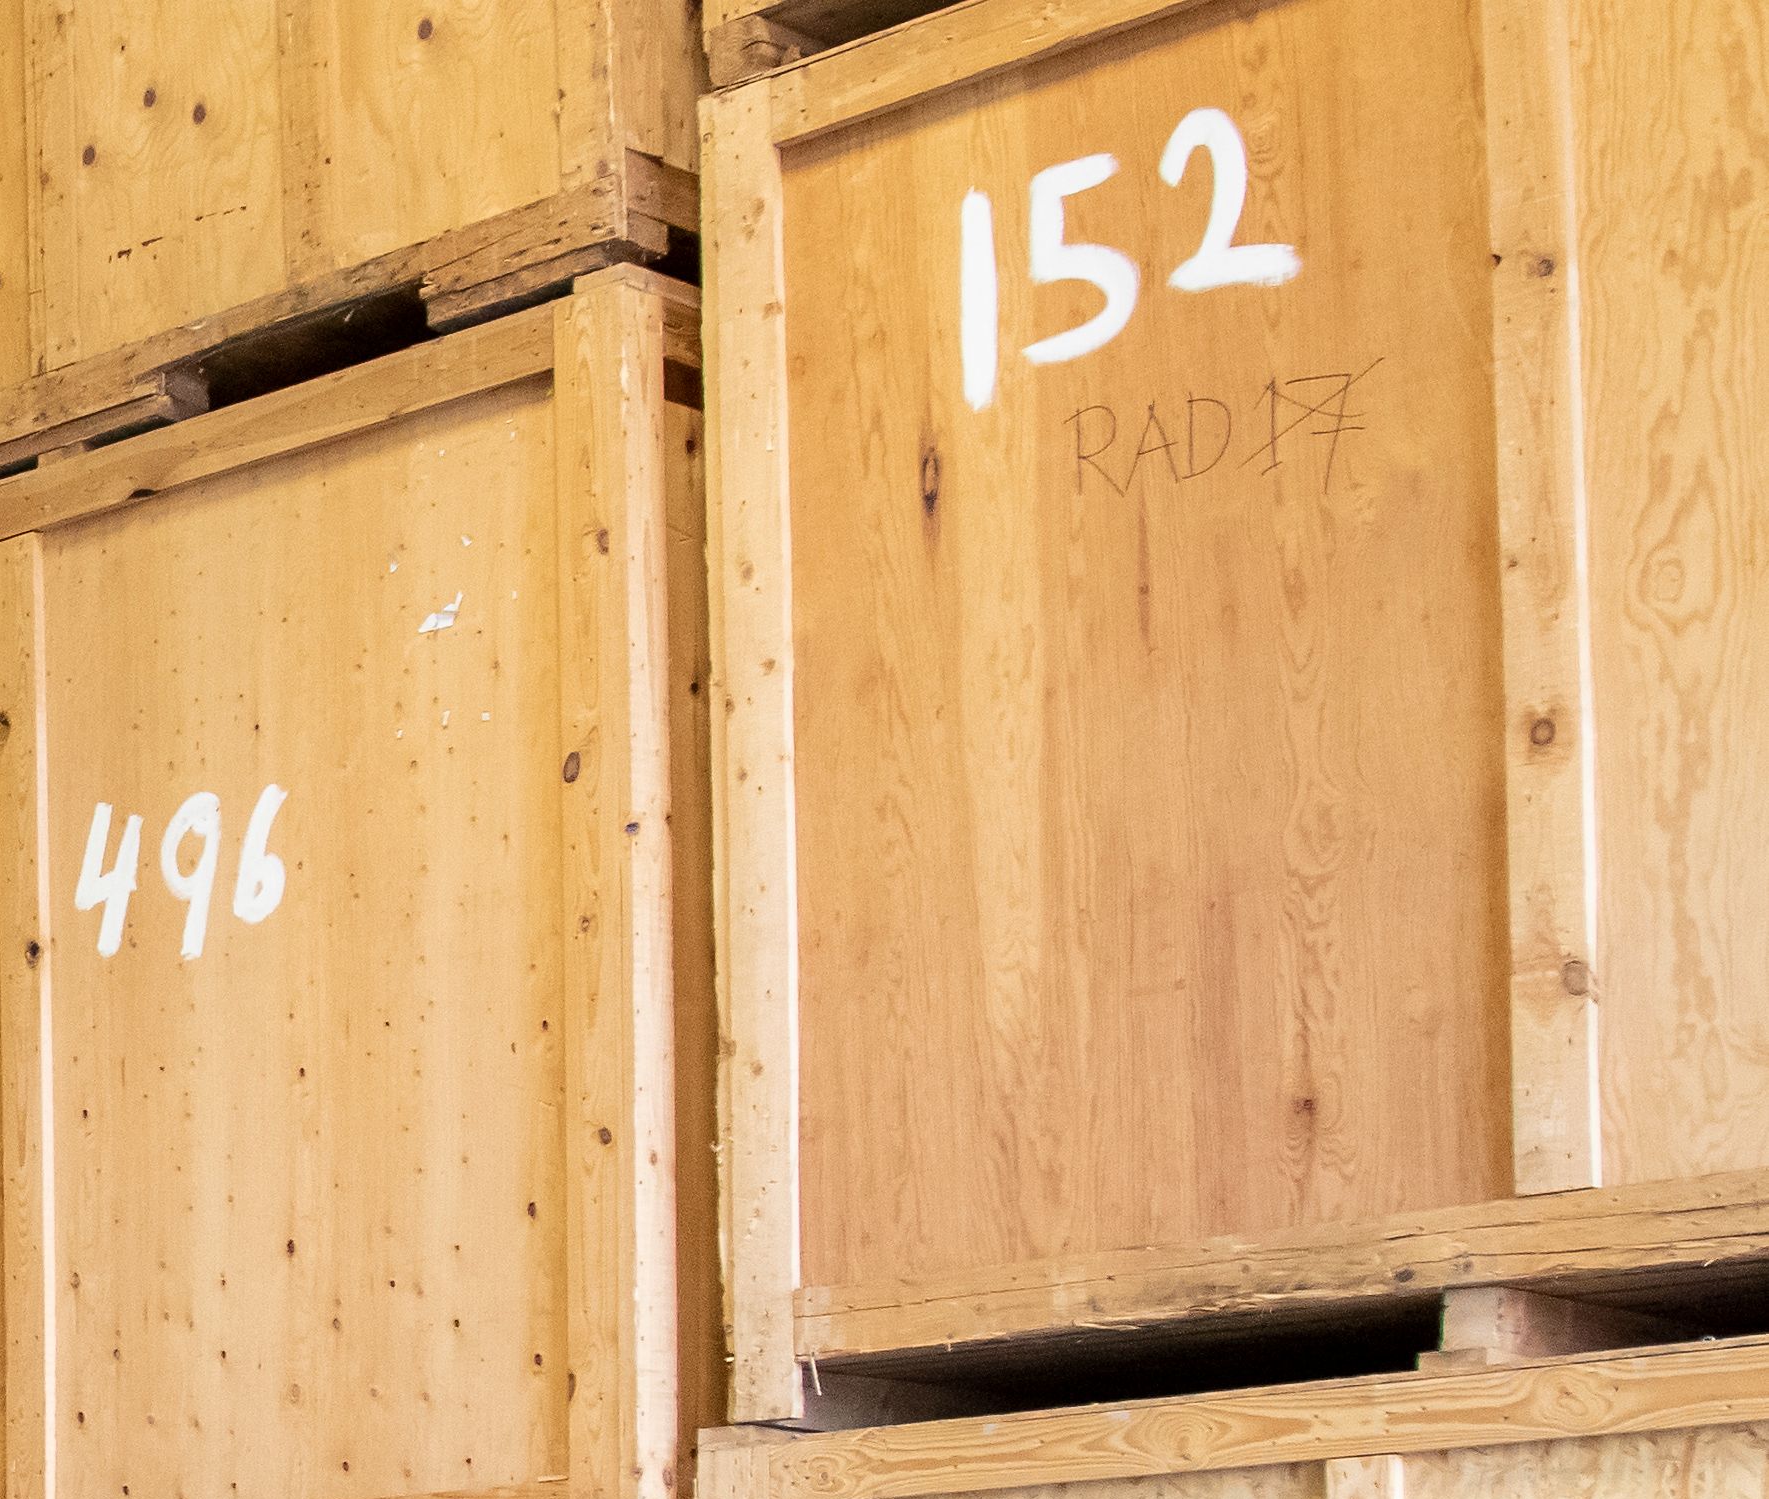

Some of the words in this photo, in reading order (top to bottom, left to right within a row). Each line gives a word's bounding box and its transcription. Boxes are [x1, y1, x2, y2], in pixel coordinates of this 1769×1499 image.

[960, 108, 1302, 413] 152
[1064, 392, 1234, 500] RAD
[74, 784, 289, 960] 496
